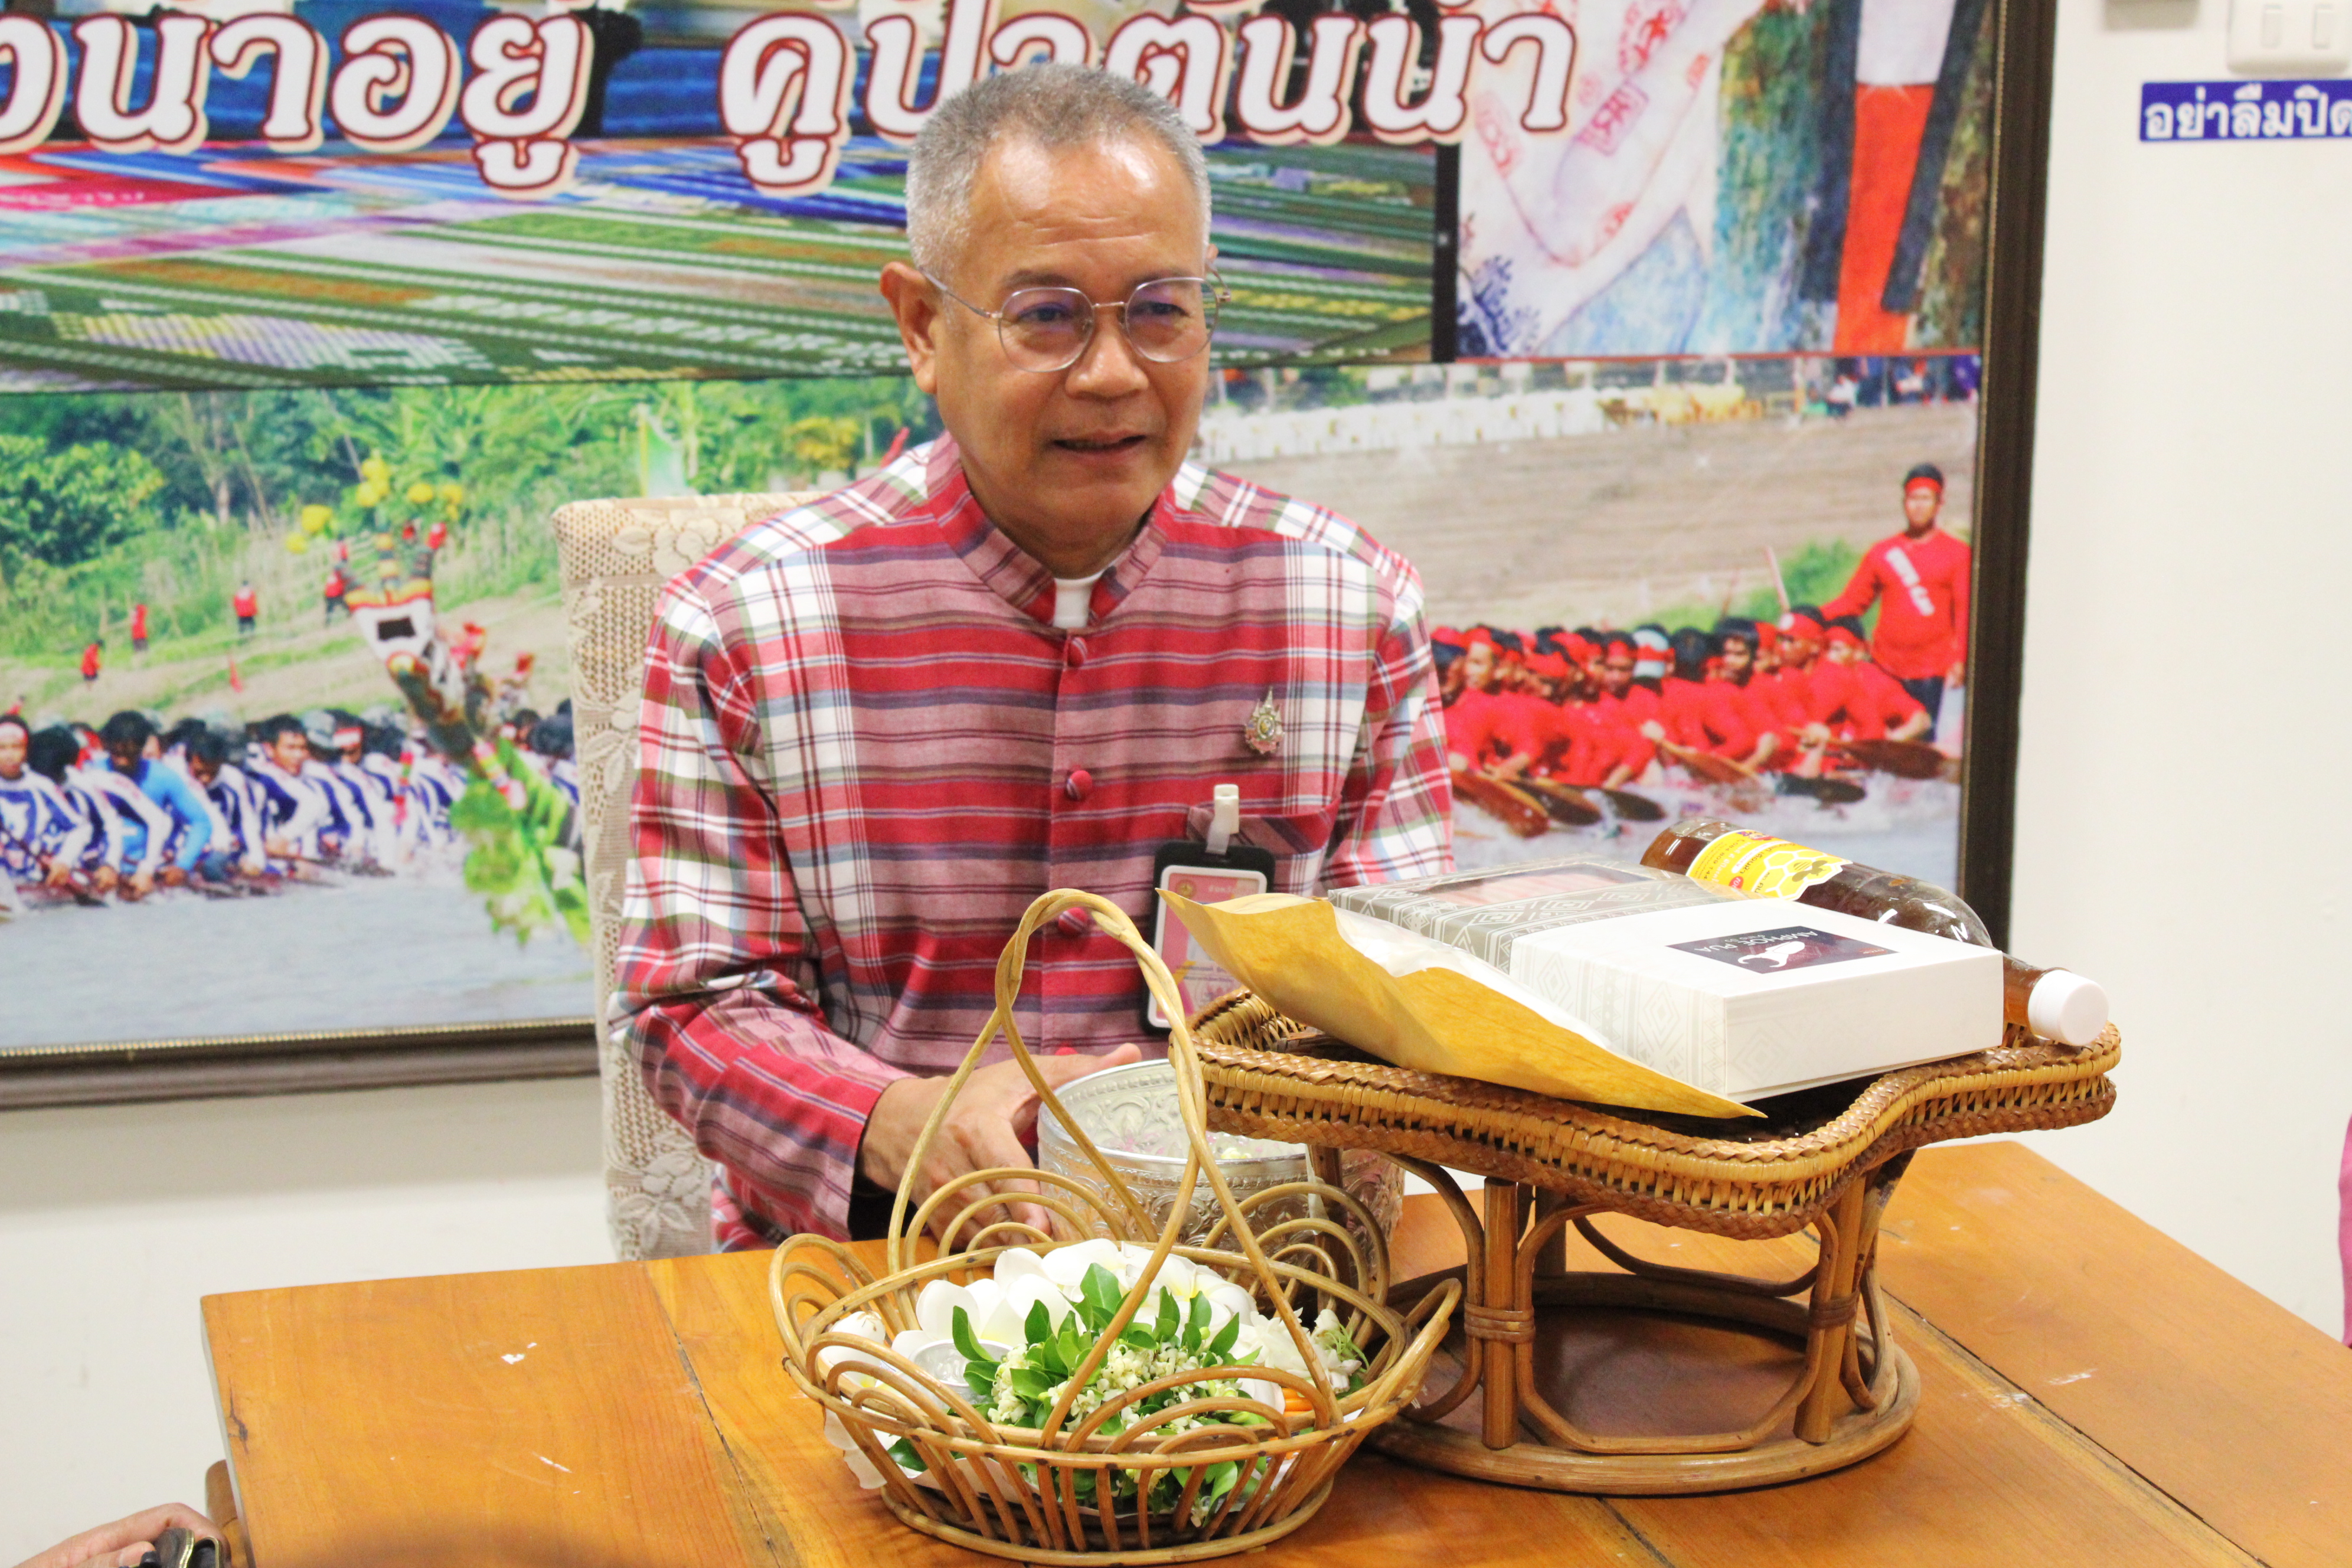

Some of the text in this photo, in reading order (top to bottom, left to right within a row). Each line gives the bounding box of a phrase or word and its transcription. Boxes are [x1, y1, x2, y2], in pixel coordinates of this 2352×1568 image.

[1703, 866, 1713, 880] 144
[1737, 930, 1818, 946] AMPHOE
[1694, 943, 1738, 952] PUA
